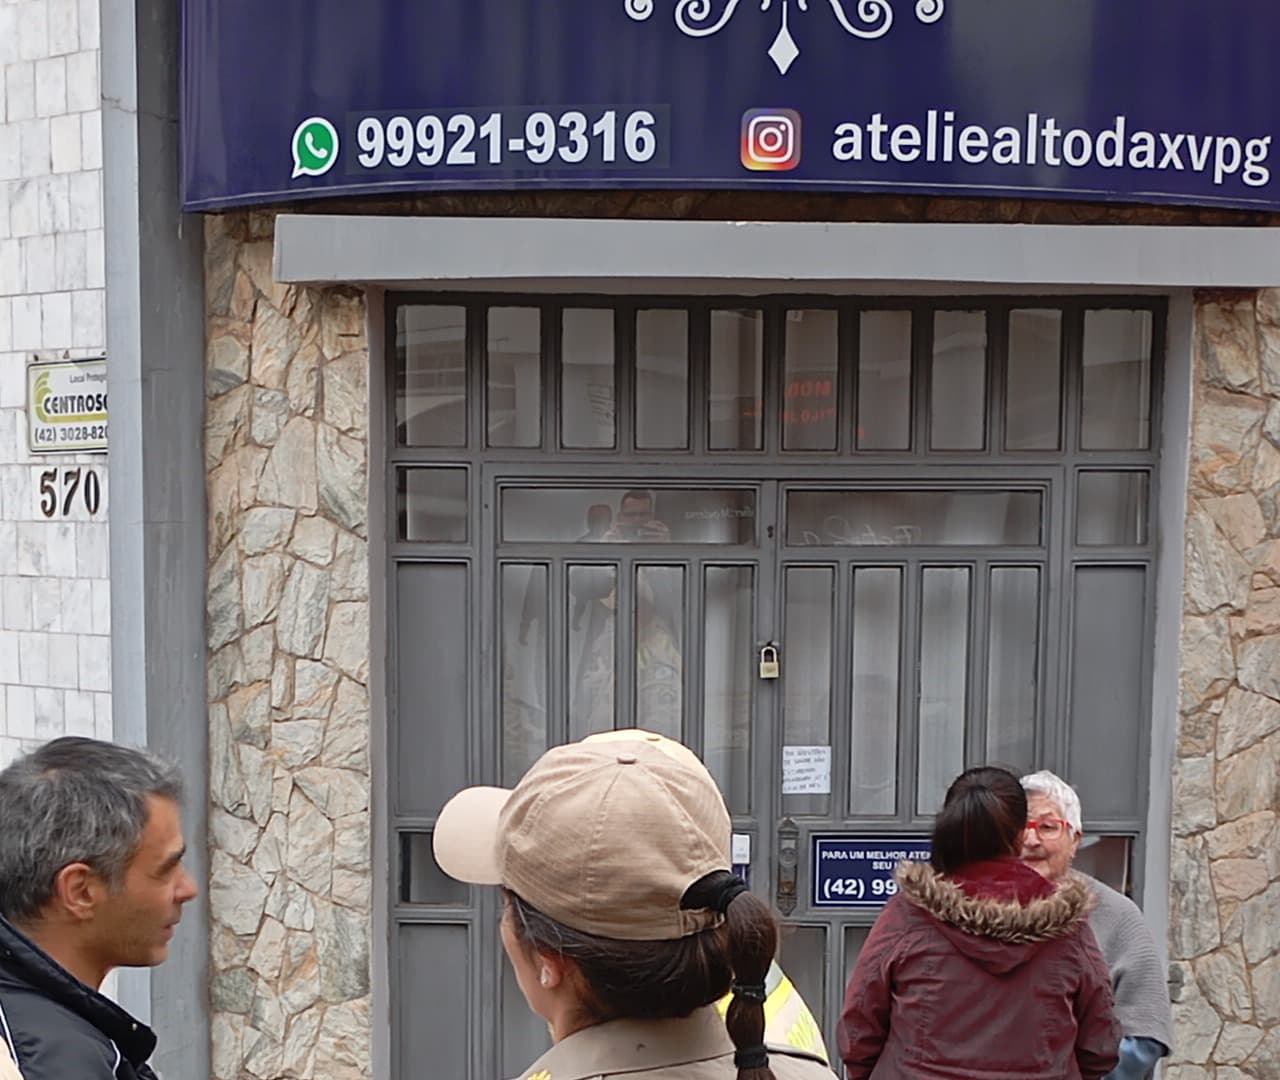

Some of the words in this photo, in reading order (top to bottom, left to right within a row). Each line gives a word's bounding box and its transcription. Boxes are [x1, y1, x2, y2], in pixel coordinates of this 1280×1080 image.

[357, 111, 656, 168] 99921-9316
[832, 110, 1271, 186] ateliealtodaxvpg
[35, 427, 57, 443] (42)
[40, 467, 100, 518] 570
[822, 851, 848, 860] PARA
[849, 851, 864, 860] UM
[866, 851, 907, 860] MELHOR
[872, 861, 892, 870] SEU
[824, 878, 865, 899] (42)
